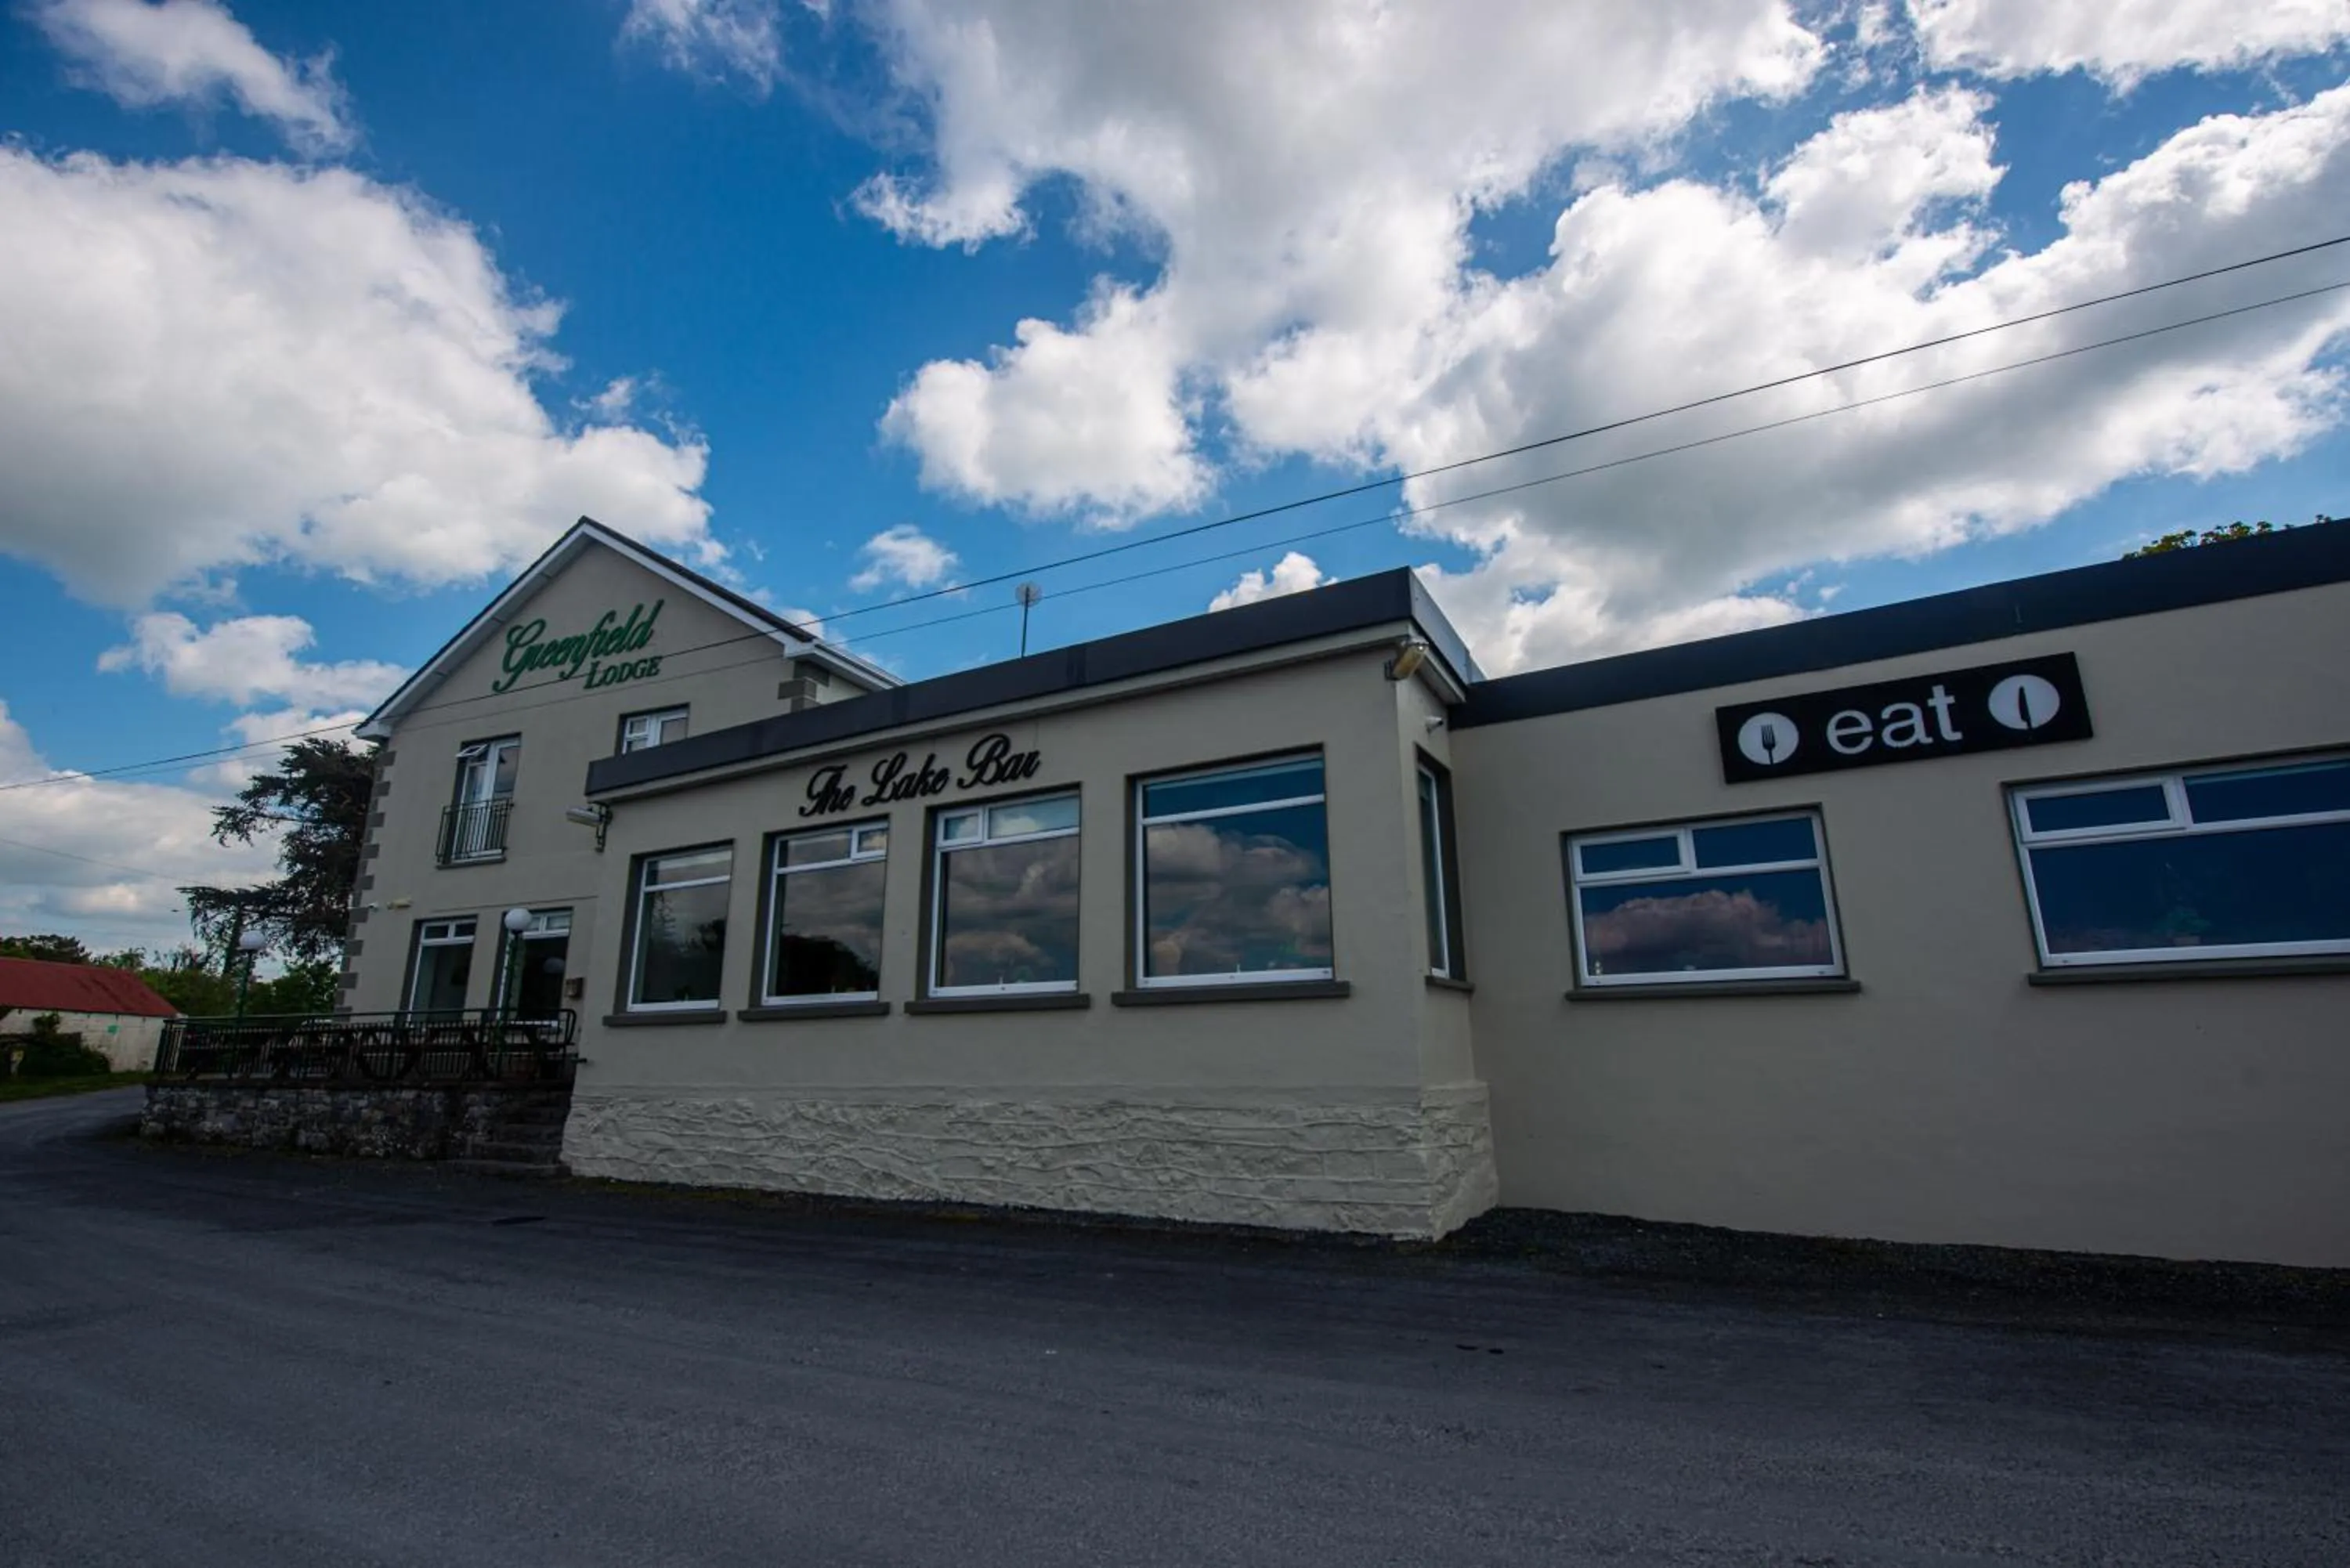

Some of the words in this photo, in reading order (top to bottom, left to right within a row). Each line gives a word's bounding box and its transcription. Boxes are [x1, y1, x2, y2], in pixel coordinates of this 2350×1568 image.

[493, 599, 664, 693] Greenfield
[1826, 684, 1962, 754] eat
[799, 764, 856, 817] The
[862, 752, 949, 807] Lake
[957, 733, 1041, 789] Bar
